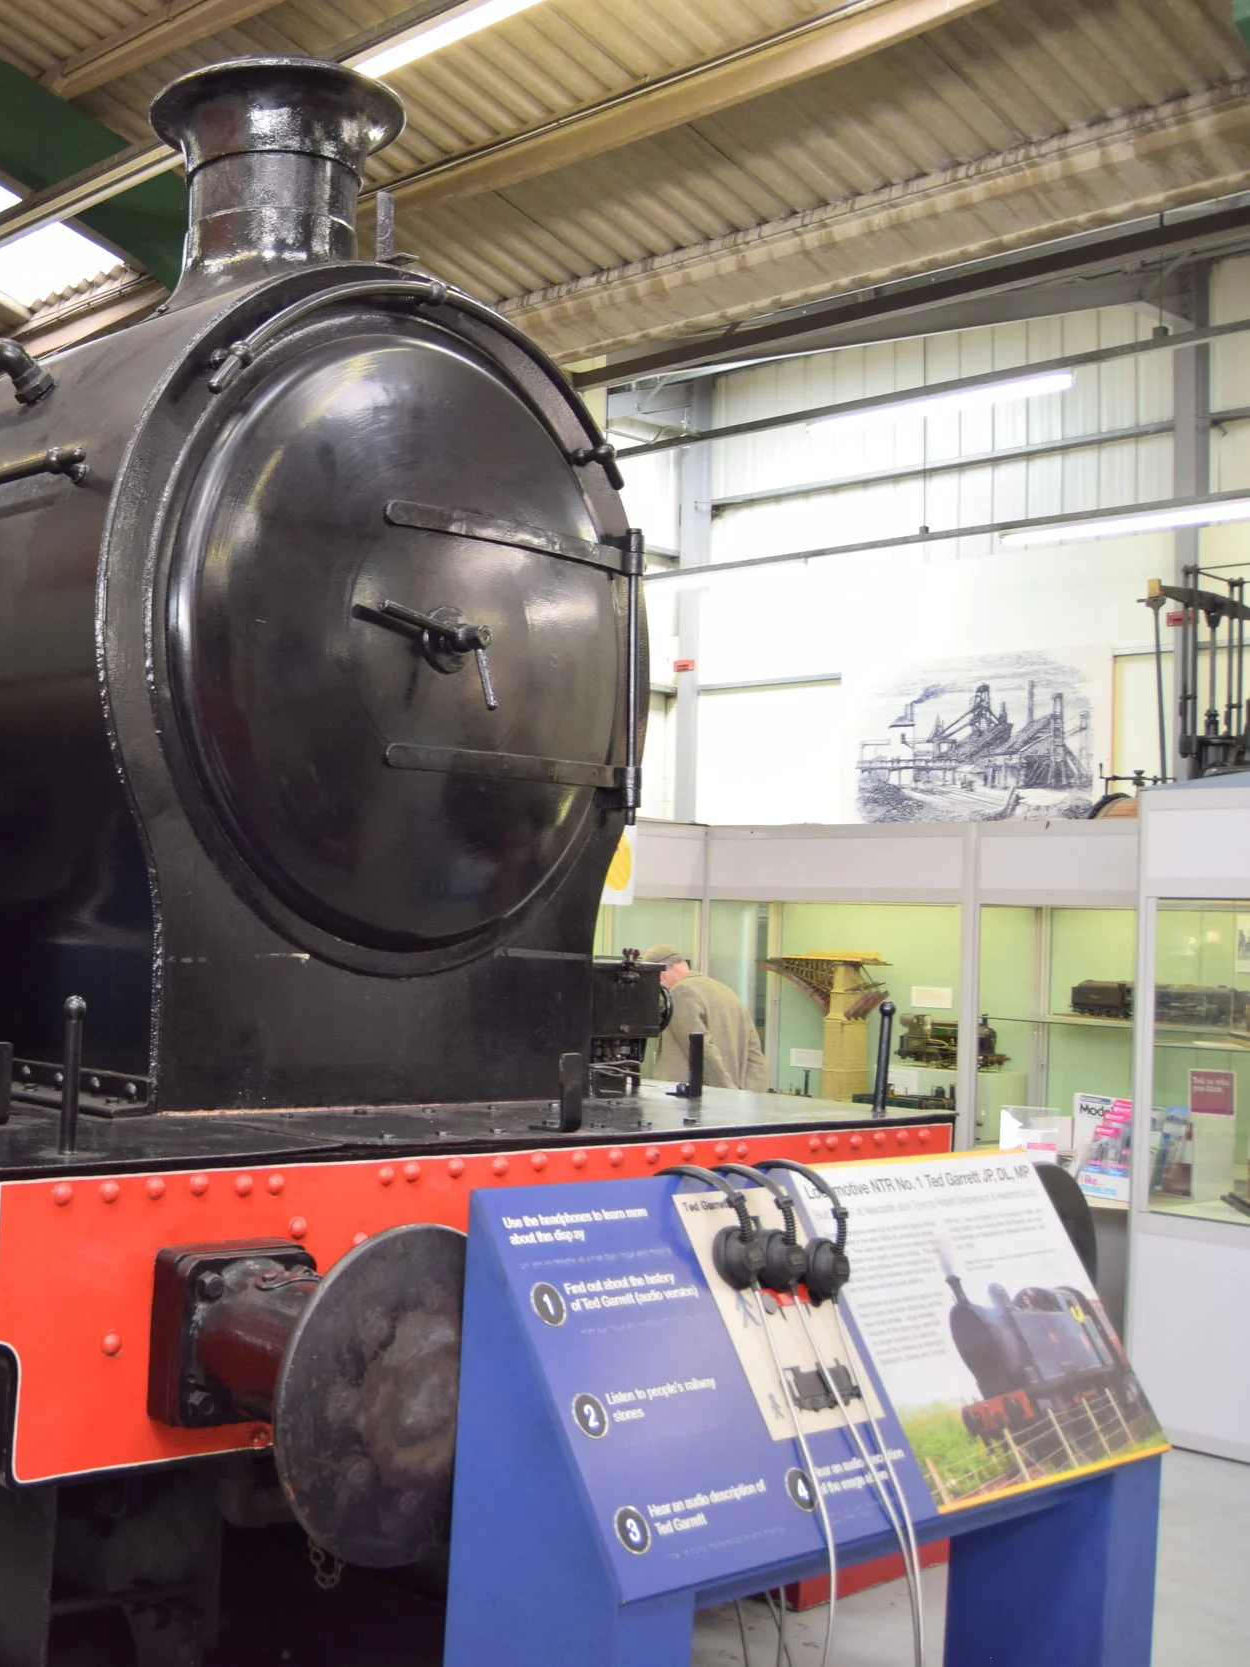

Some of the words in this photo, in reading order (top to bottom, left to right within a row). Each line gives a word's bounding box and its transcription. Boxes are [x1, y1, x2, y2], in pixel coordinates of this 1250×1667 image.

[869, 1179, 896, 1193] NTR
[894, 1177, 916, 1190] No.
[923, 1172, 945, 1187] Ted
[945, 1172, 981, 1185] Garrett
[1013, 1165, 1030, 1178] MP
[502, 1216, 525, 1229] Use
[525, 1214, 539, 1227] the
[539, 1211, 593, 1226] headphones
[592, 1210, 603, 1221] to
[603, 1208, 625, 1220] learn
[625, 1206, 649, 1218] more
[682, 1201, 700, 1213] Ted
[509, 1231, 537, 1245] about
[536, 1230, 554, 1242] this
[563, 1283, 587, 1295] Find
[587, 1280, 603, 1293] out
[603, 1278, 629, 1290] about
[628, 1275, 646, 1287] the
[645, 1272, 676, 1286] history
[543, 1293, 555, 1316] 1
[570, 1300, 582, 1312] of
[582, 1297, 601, 1310] Ted
[600, 1293, 636, 1308] Garrett
[636, 1290, 664, 1305] (audio
[663, 1285, 700, 1301] version)
[605, 1391, 636, 1405] Listen
[634, 1388, 647, 1399] to
[646, 1381, 684, 1400] people's
[683, 1378, 716, 1390] railway
[583, 1403, 599, 1428] 2
[830, 1463, 844, 1475] an
[842, 1457, 865, 1471] audio
[647, 1503, 672, 1517] Hear
[671, 1501, 686, 1512] an
[684, 1493, 710, 1509] audio
[709, 1484, 758, 1503] description
[755, 1478, 767, 1492] of
[797, 1478, 809, 1500] 4
[626, 1518, 641, 1543] 3
[653, 1520, 675, 1535] Ted
[672, 1512, 708, 1531] Garrett
